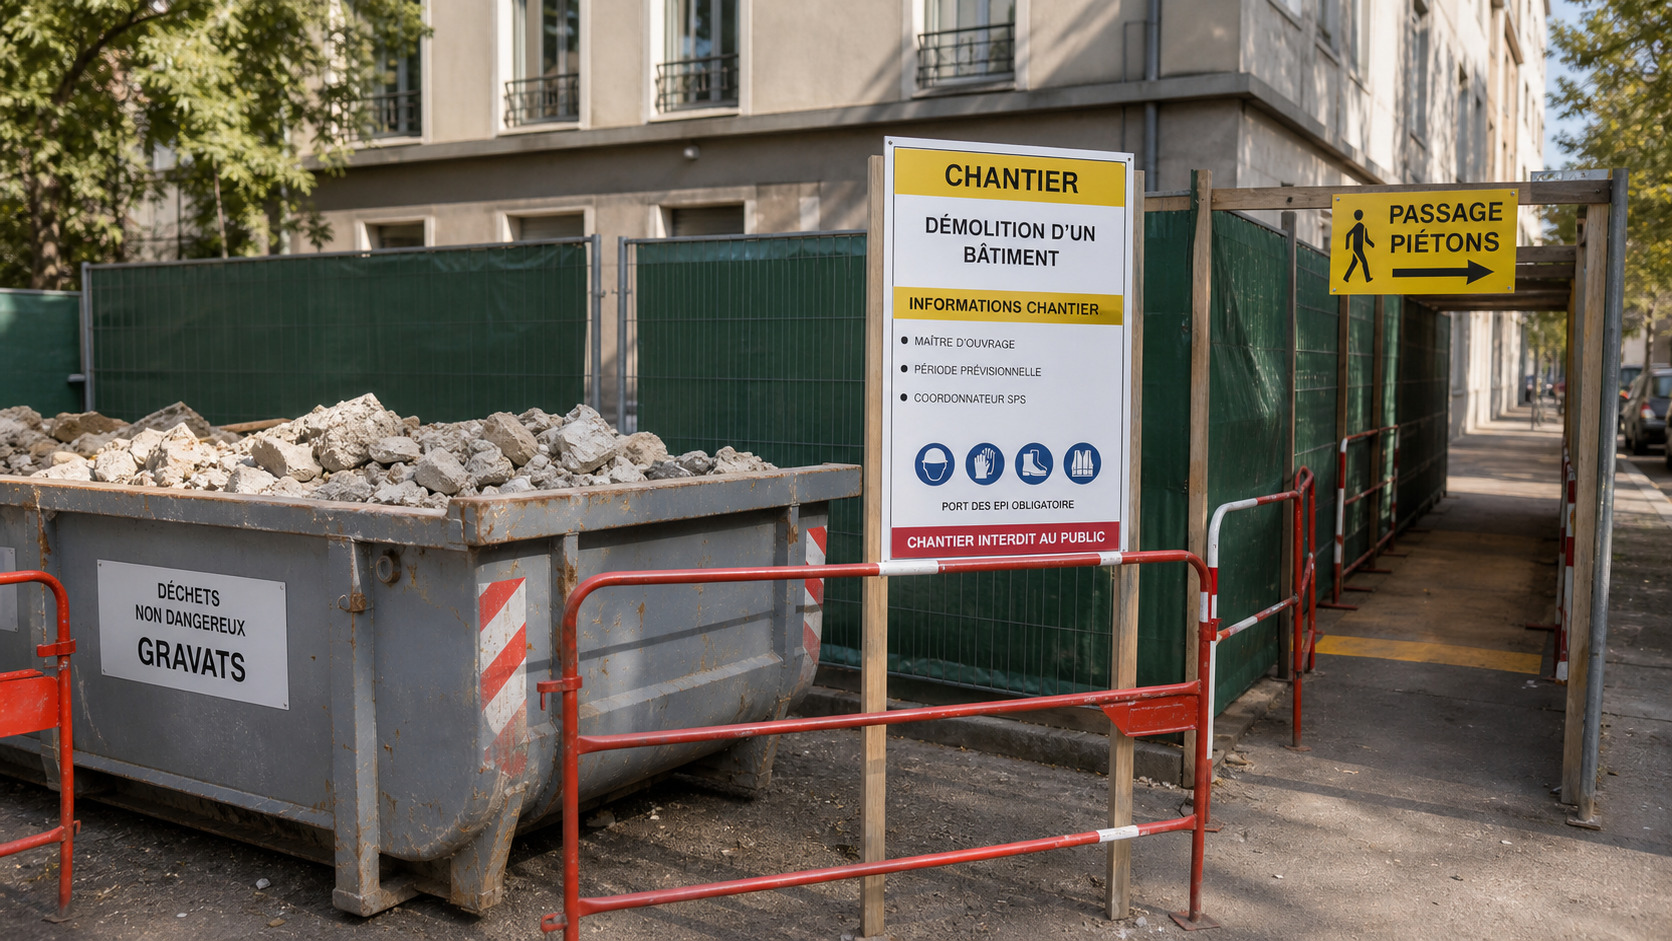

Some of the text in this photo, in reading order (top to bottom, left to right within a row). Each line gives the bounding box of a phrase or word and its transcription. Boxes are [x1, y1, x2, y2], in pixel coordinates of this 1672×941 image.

[945, 164, 1079, 194] CHANTIER
[1390, 202, 1503, 224] PASSAGE
[925, 213, 1045, 239] DÉMOLITION
[1390, 229, 1499, 253] PIÉTONS
[963, 243, 1059, 267] BÂTIMENT
[909, 297, 1099, 316] INFORMATIONS CHANTIER
[914, 363, 1042, 377] PÉRIODE PRÉVISIONNELLE
[914, 393, 1026, 405] COORDONNATEUR SPS
[942, 500, 1075, 511] PORT DES EPI OBLIGATOIRE
[907, 531, 1105, 548] CHANTIER INTERDIT AU PUBLIC
[157, 580, 220, 607] DÉCHETS
[135, 604, 246, 637] NON DANGEREUX
[137, 637, 246, 682] GRAVATS
